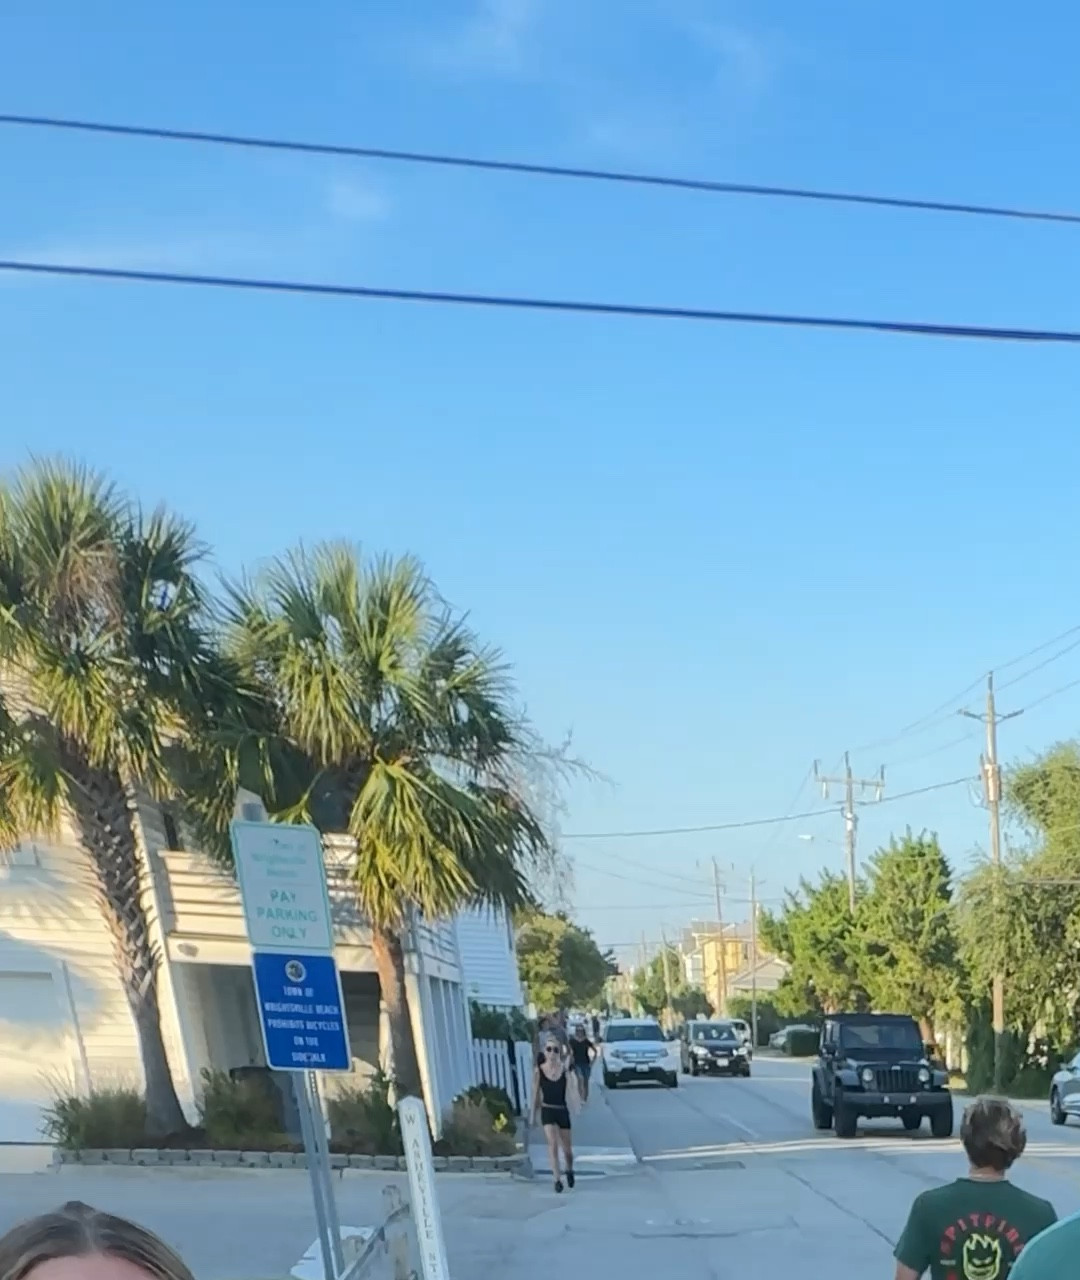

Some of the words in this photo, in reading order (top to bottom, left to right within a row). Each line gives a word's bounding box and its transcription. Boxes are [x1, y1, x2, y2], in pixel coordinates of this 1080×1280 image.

[270, 889, 296, 903] PAY
[256, 906, 317, 922] PARKING
[271, 925, 307, 939] ONLY
[305, 1021, 340, 1031] BICYCLES
[404, 1112, 415, 1125] W
